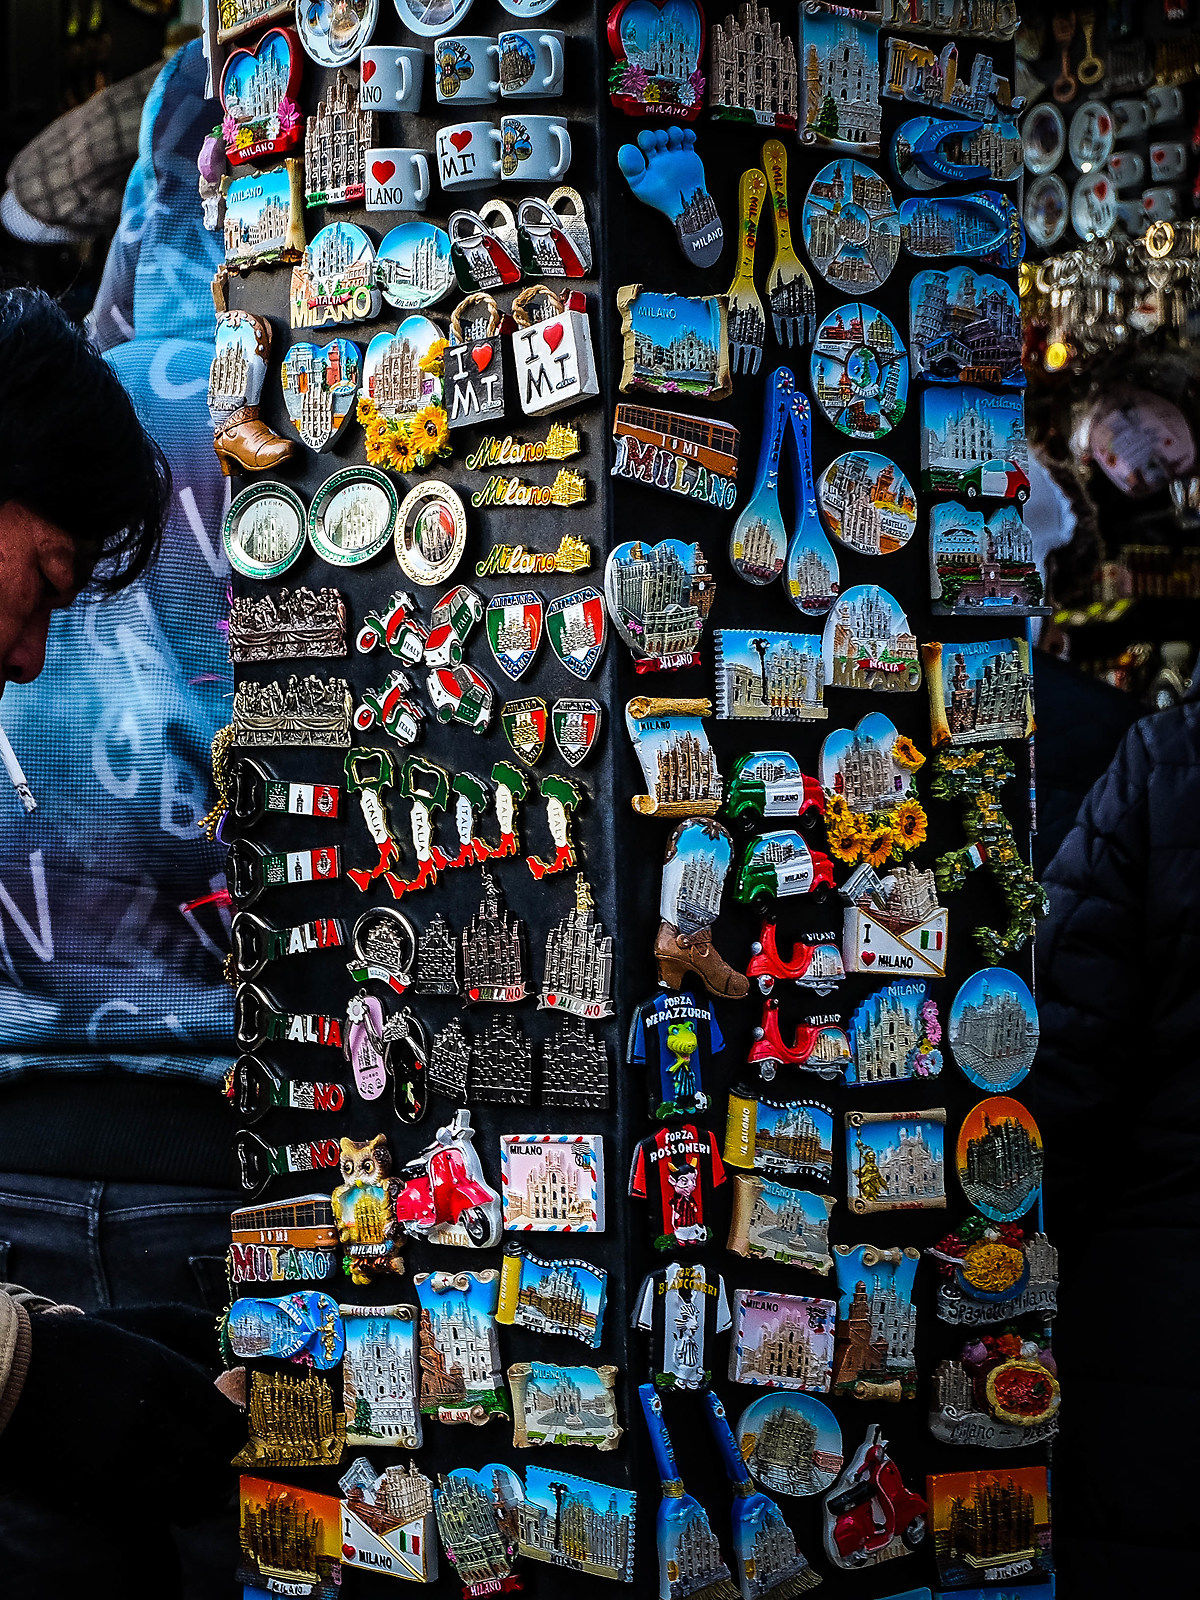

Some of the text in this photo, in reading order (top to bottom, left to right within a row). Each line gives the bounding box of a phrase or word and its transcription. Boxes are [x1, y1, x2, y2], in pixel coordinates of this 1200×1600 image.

[645, 105, 689, 117] MILANO
[930, 121, 960, 142] MILANO
[238, 140, 275, 159] MILANO
[932, 160, 965, 180] MILANO
[229, 185, 263, 203] MILANO
[774, 164, 789, 221] MILANO
[745, 194, 758, 249] MILANO
[691, 228, 724, 251] MILANO
[315, 293, 344, 306] ITALIA
[395, 298, 418, 309] MILANO
[637, 306, 677, 321] MILANO
[521, 330, 539, 362] I
[450, 348, 469, 381] I
[527, 353, 574, 397] MI
[452, 376, 499, 419] MI
[301, 430, 329, 448] MILANO
[466, 435, 546, 470] Milano
[620, 435, 737, 510] MILANO
[472, 476, 553, 507] Milano
[882, 518, 908, 532] CASTELLO
[850, 543, 878, 555] MILANO
[477, 545, 557, 578] Milano
[492, 594, 535, 607] MILANO
[551, 590, 593, 611] MILANO
[456, 606, 472, 633] ITALY
[404, 640, 420, 657] ITALY
[659, 655, 694, 670] MILANO
[507, 701, 538, 712] MILANO
[559, 702, 591, 712] MILANO
[398, 721, 416, 738] ITALY
[640, 720, 671, 730] MILANO
[773, 794, 799, 803] MILANO
[365, 798, 381, 838] ITALIA
[499, 794, 508, 828] ITALY
[460, 804, 469, 840] ITALY
[552, 807, 562, 842] ITALY
[416, 812, 426, 853] ITALIA
[806, 931, 836, 942] MILANO
[863, 924, 871, 944] I
[878, 954, 914, 970] MILANO
[479, 986, 522, 1001] MILANO
[887, 983, 926, 997] MILANO
[558, 996, 601, 1016] MILANO
[664, 997, 693, 1009] FORZA
[646, 1009, 712, 1029] NERAZZURRI
[809, 1014, 841, 1026] MILANO
[741, 1108, 751, 1142] DUOMO
[664, 1130, 694, 1142] FORZA
[509, 1145, 542, 1157] MILANO
[650, 1144, 711, 1163] ROSSONERI
[349, 1244, 386, 1257] MILANO
[230, 1243, 327, 1283] MILANO
[501, 1264, 510, 1295] DUOMO
[279, 1301, 303, 1326] MILANO
[746, 1300, 779, 1313] MILANO
[281, 1340, 304, 1358] ITALIA
[345, 1517, 351, 1536] I
[358, 1550, 392, 1571] MILANO
[469, 1580, 503, 1597] MILANO
